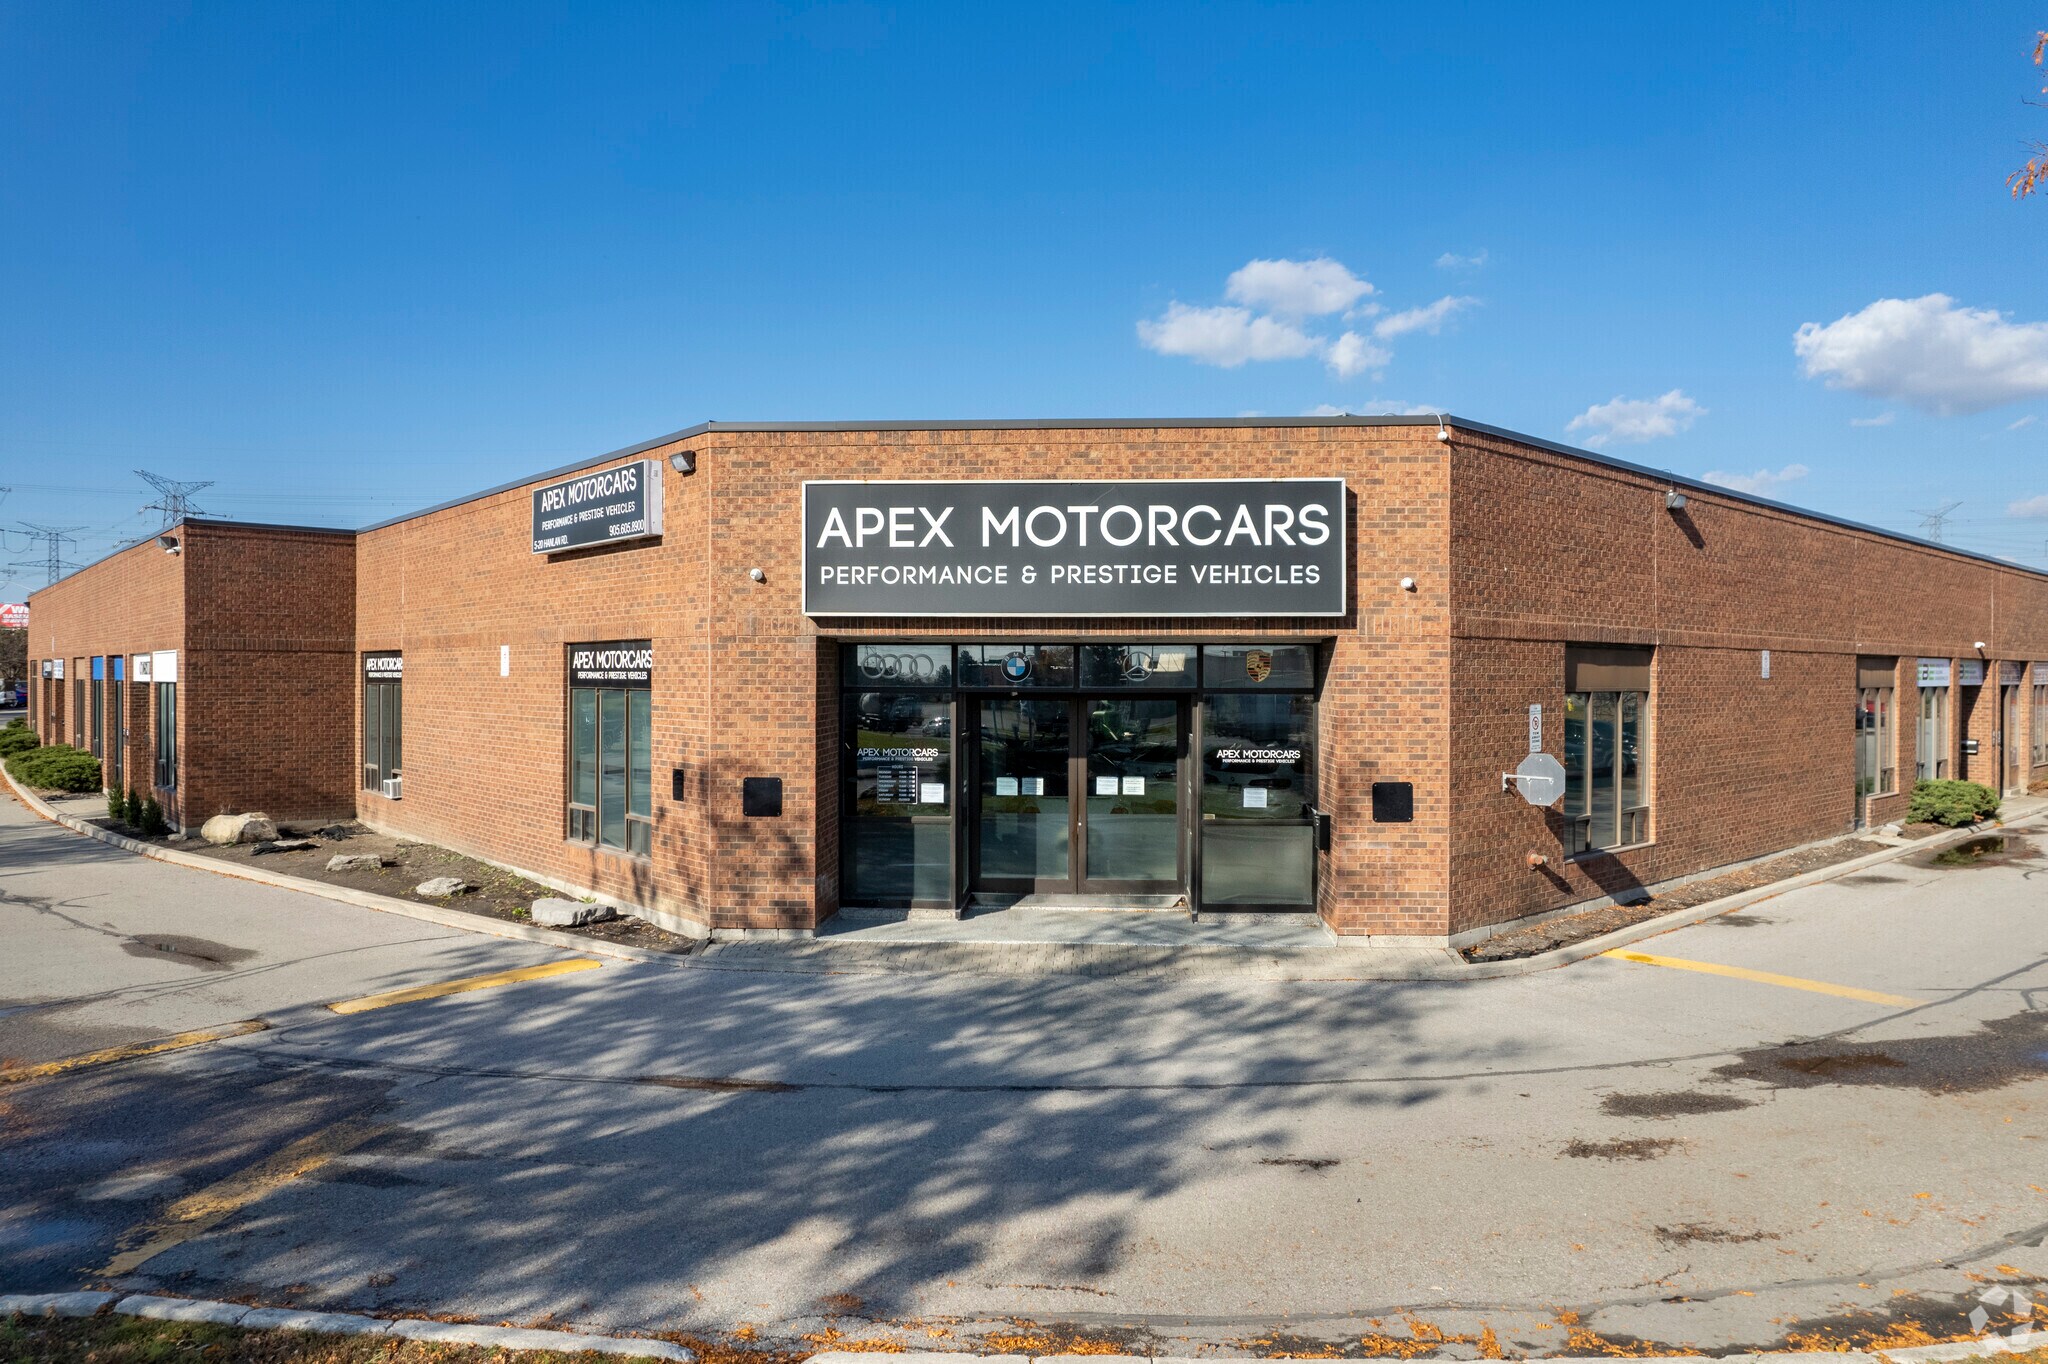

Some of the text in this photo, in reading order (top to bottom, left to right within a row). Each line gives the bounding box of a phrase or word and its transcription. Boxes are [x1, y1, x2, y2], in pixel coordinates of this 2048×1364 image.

[541, 468, 636, 512] APEX MOTORCARS
[542, 515, 573, 531] PERFORMANCE
[579, 508, 604, 521] PRESTIGE
[606, 501, 635, 515] VEHICLES
[816, 503, 1331, 548] APEX MOTORCARS
[820, 563, 1321, 585] PERFORMANCE & PRESTIGE VEHICLES
[366, 657, 403, 670] APEX MOTORCAR
[573, 650, 653, 668] APEX MOTORCARS
[857, 748, 938, 756] APEX MOTORCARS
[1217, 750, 1300, 758] APEX MOTORCARS
